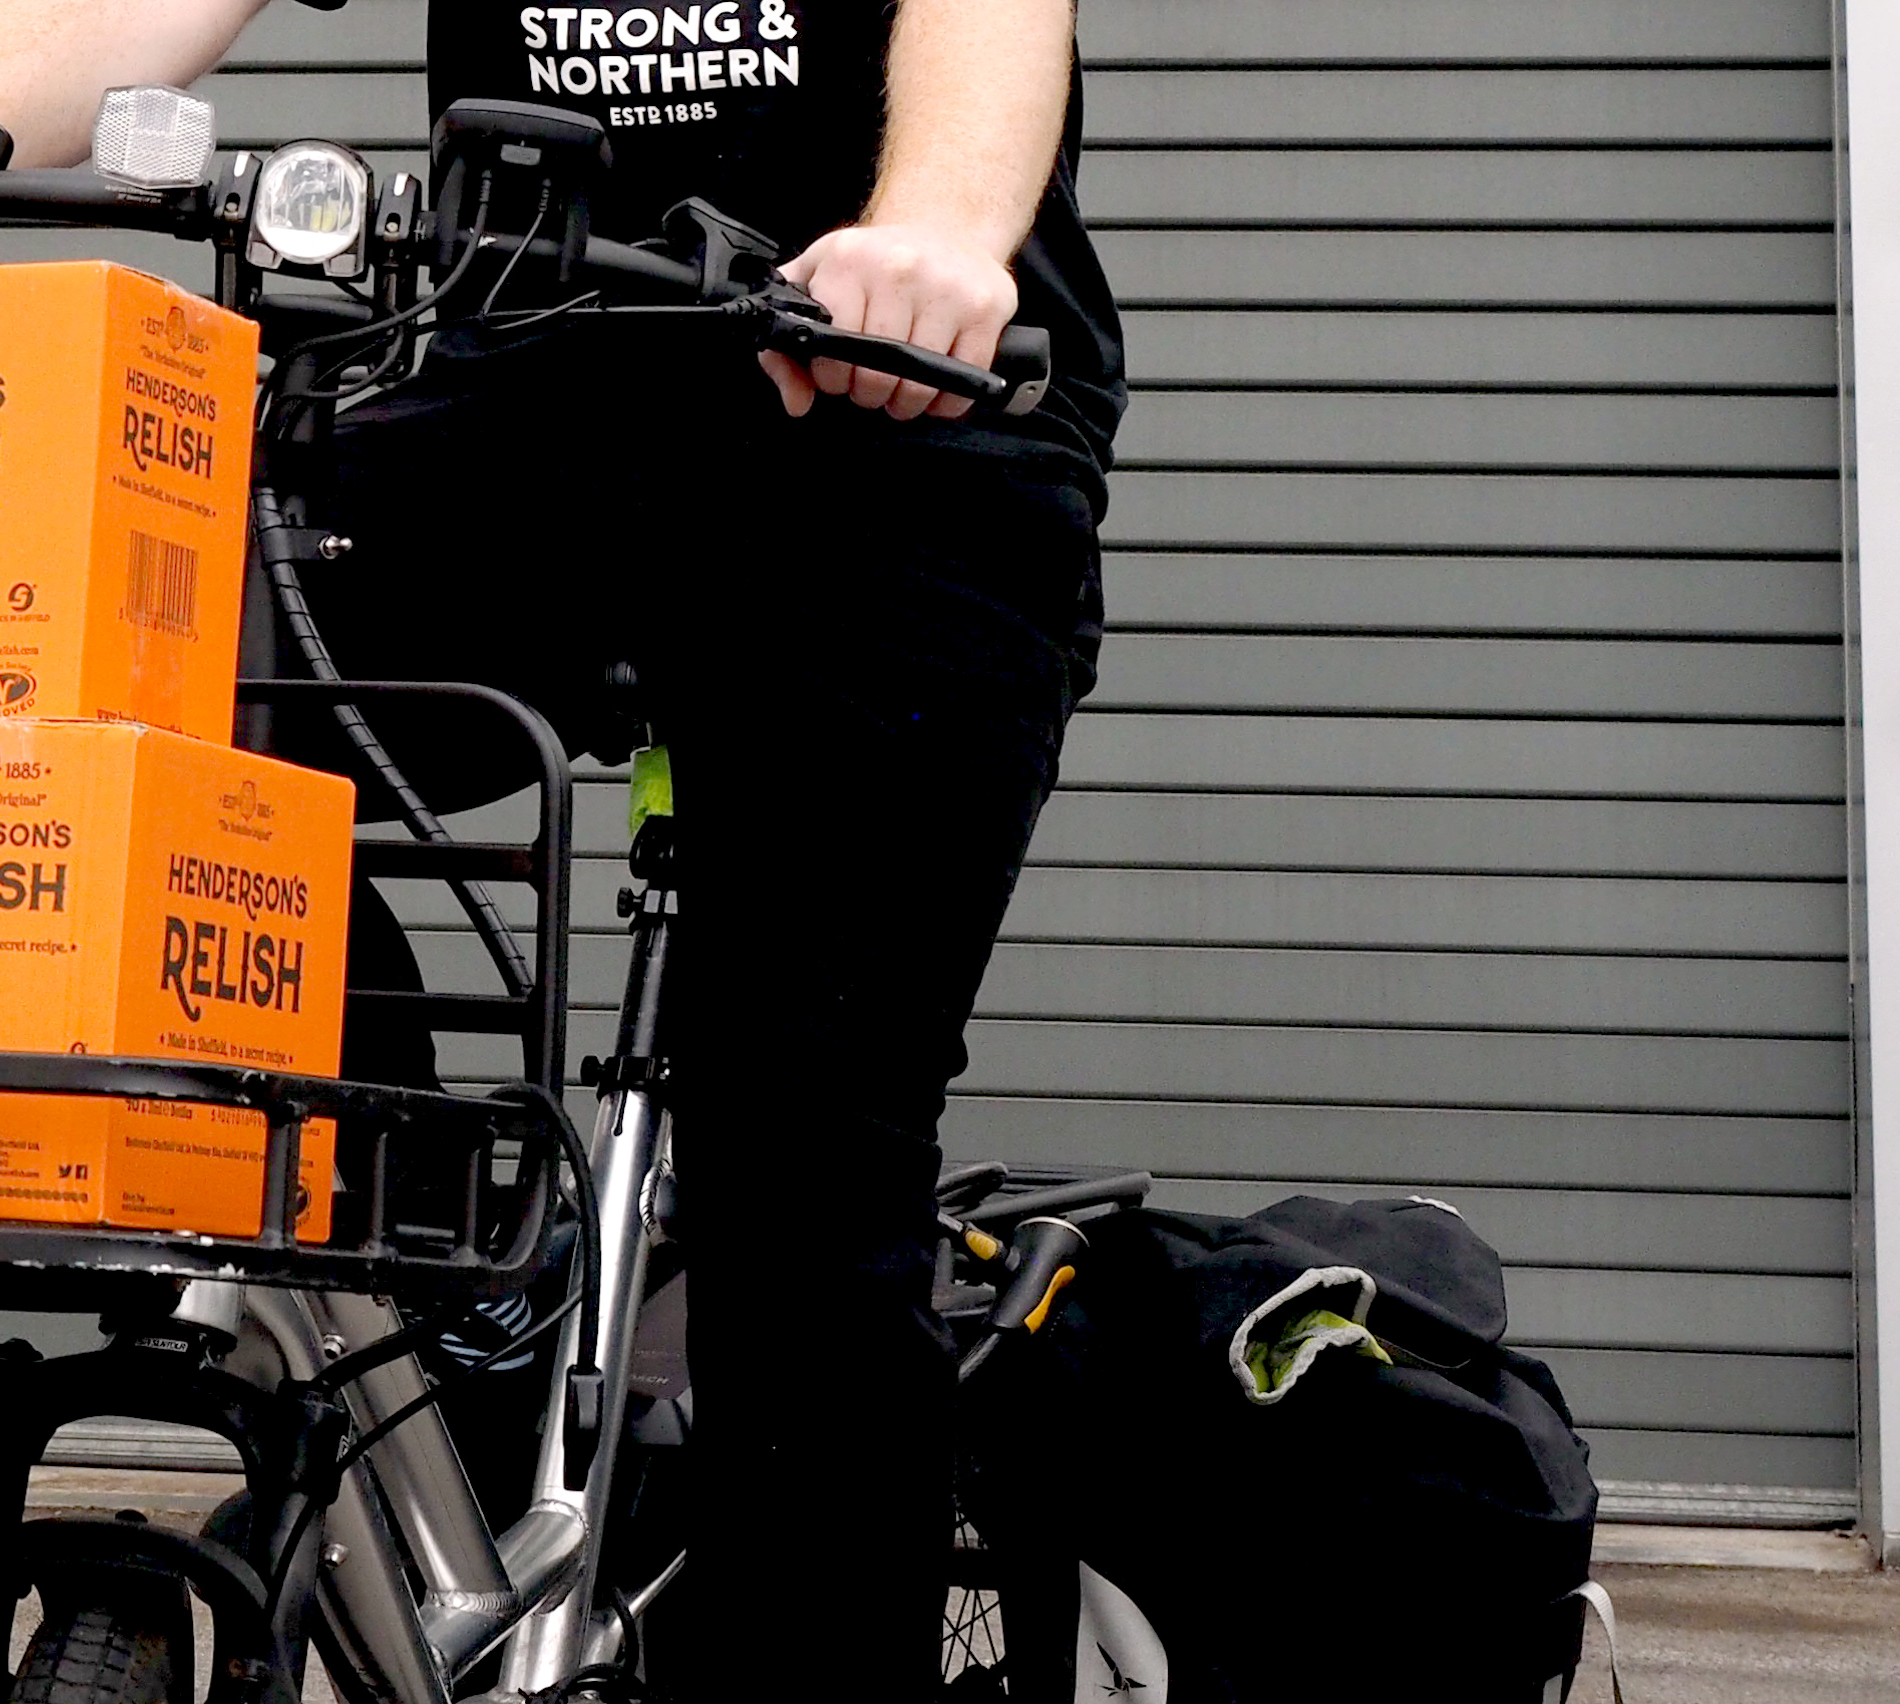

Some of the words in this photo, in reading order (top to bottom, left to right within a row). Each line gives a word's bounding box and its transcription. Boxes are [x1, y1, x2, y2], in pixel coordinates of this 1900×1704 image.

[520, 1, 740, 51] STRONG
[528, 45, 799, 96] NORTHERN
[610, 106, 662, 127] ESTD
[664, 101, 718, 123] 1885
[125, 366, 216, 423] HENDERSON'S
[123, 404, 214, 480] RELISH
[5, 762, 41, 779] 1885
[168, 853, 307, 922] HENDERSON'S
[29, 939, 67, 956] recipe.
[160, 915, 303, 1023] RELISH
